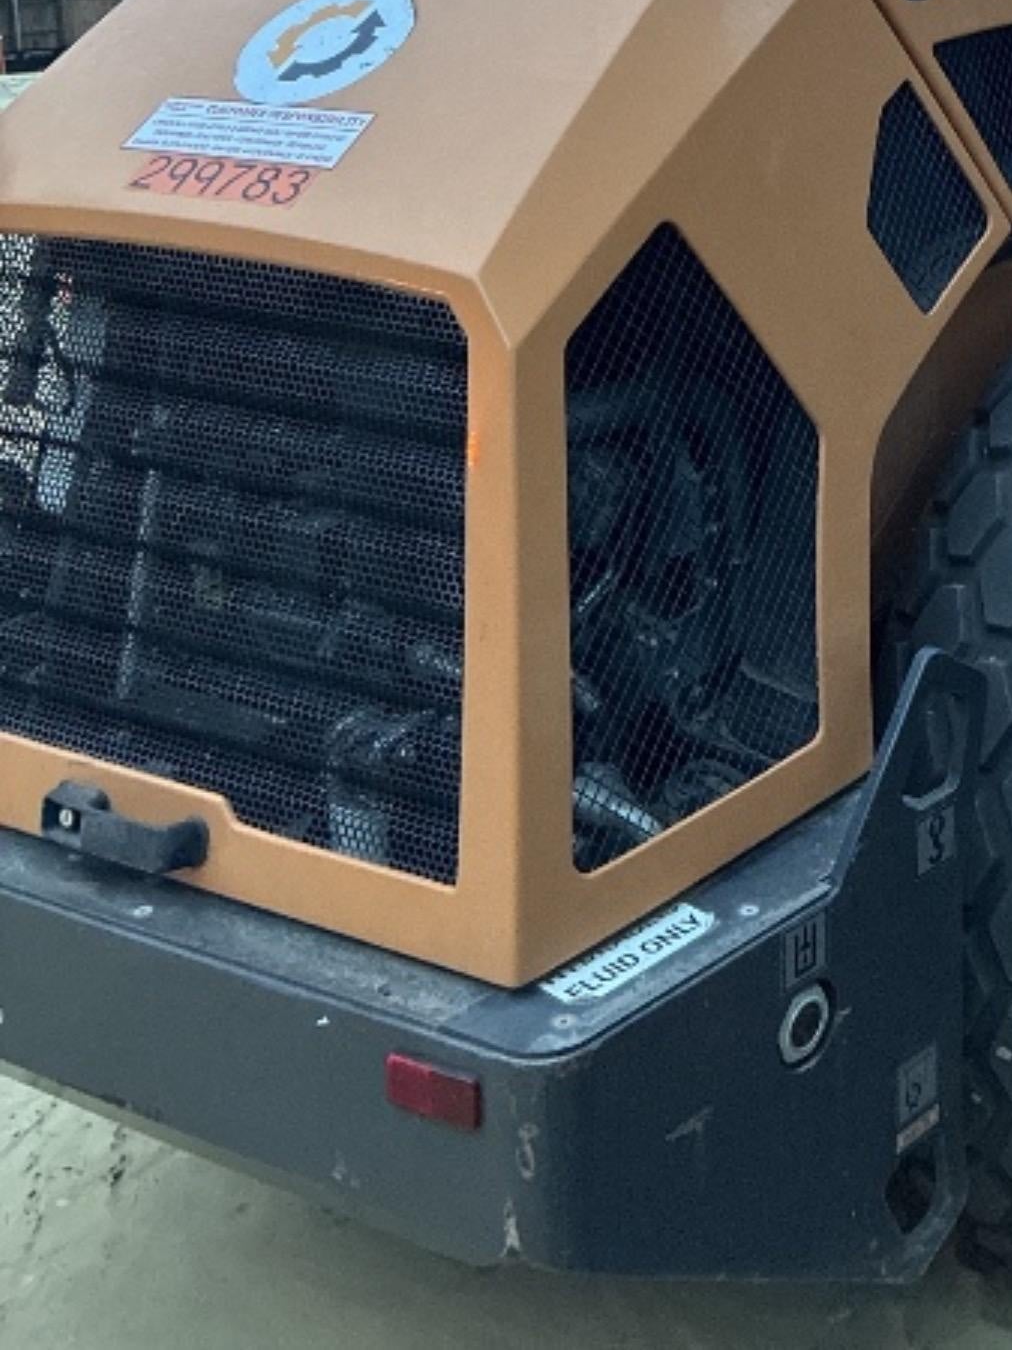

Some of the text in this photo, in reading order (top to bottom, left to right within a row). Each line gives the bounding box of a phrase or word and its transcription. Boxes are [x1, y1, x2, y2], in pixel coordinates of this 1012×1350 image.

[130, 155, 310, 205] 299783
[564, 952, 640, 997] FLUID
[640, 912, 703, 954] ONLY
